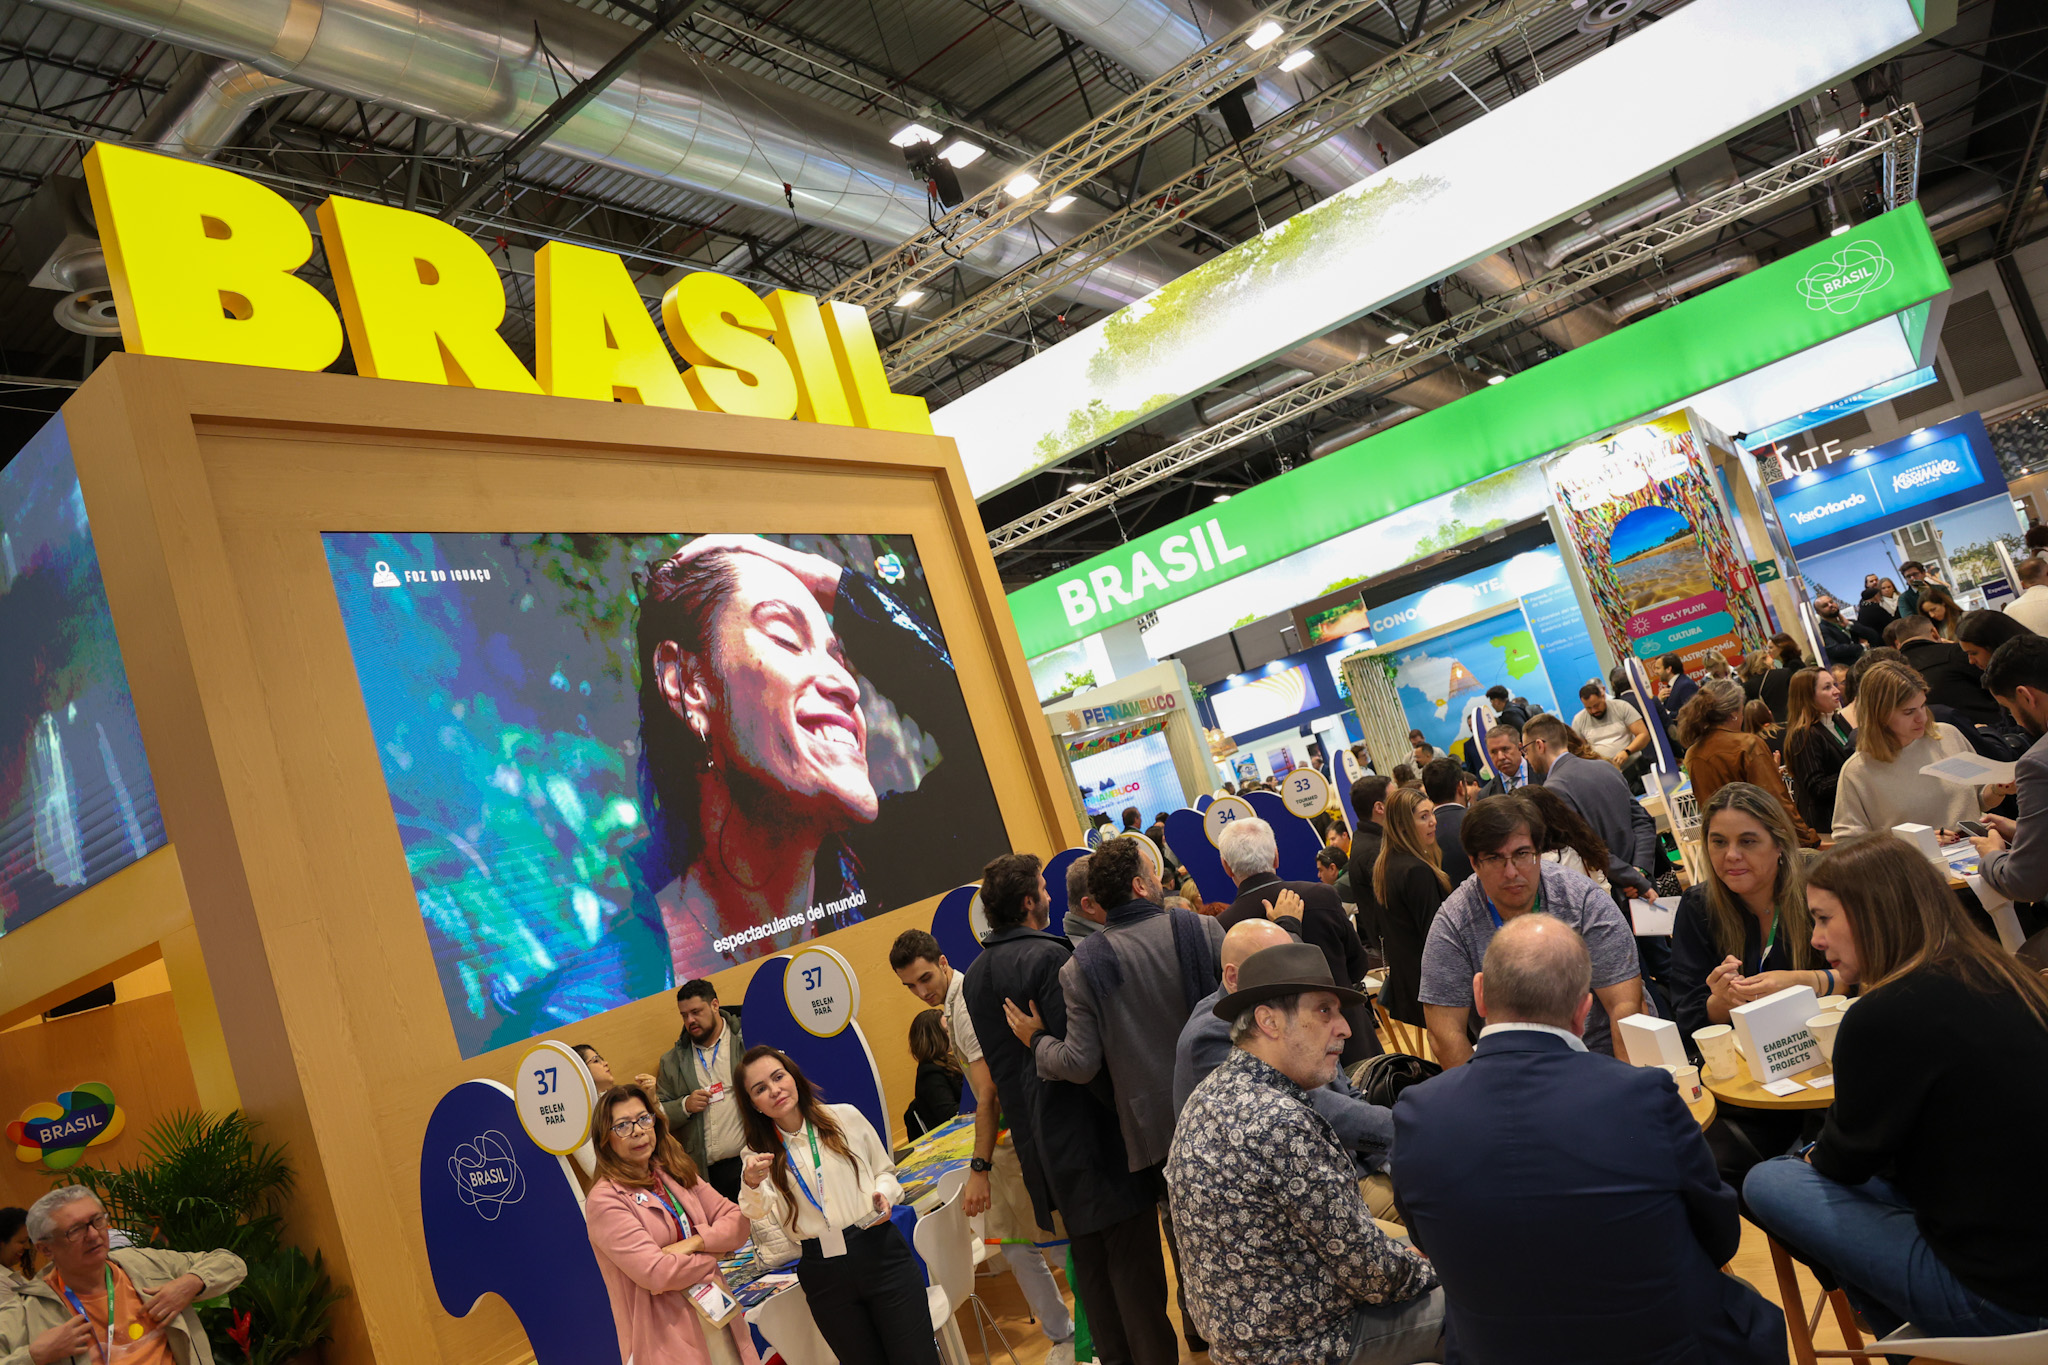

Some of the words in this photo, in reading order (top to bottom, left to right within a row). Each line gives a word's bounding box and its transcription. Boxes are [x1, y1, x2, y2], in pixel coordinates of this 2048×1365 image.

[83, 142, 935, 436] BRASIL
[1823, 267, 1873, 294] BRASIL
[404, 570, 428, 583] FOZ
[430, 570, 447, 582] DO
[450, 569, 491, 583] IGUAÇU
[1057, 518, 1247, 627] BRASIL
[1661, 612, 1678, 623] SOL
[1675, 610, 1682, 618] Y
[1682, 602, 1707, 615] PLAYA
[1668, 626, 1703, 642] CULTURA
[1680, 640, 1736, 663] ASTRONOMÍA
[1082, 693, 1176, 726] PERNAMBUCO
[1294, 778, 1311, 793] 33
[1217, 808, 1236, 824] 34
[713, 913, 806, 953] espectaculares
[806, 903, 826, 922] del
[826, 889, 868, 916] mundo!
[802, 966, 822, 990] 37
[811, 996, 834, 1008] BELEM
[1763, 1030, 1809, 1053] EMBRATUR
[1766, 1038, 1818, 1063] STRUCTURIN
[1770, 1051, 1811, 1073] PROJECTS
[533, 1067, 557, 1096] 37
[539, 1103, 565, 1116] BELEM
[40, 1114, 102, 1143] BRASIL
[469, 1168, 508, 1187] BRASIL
